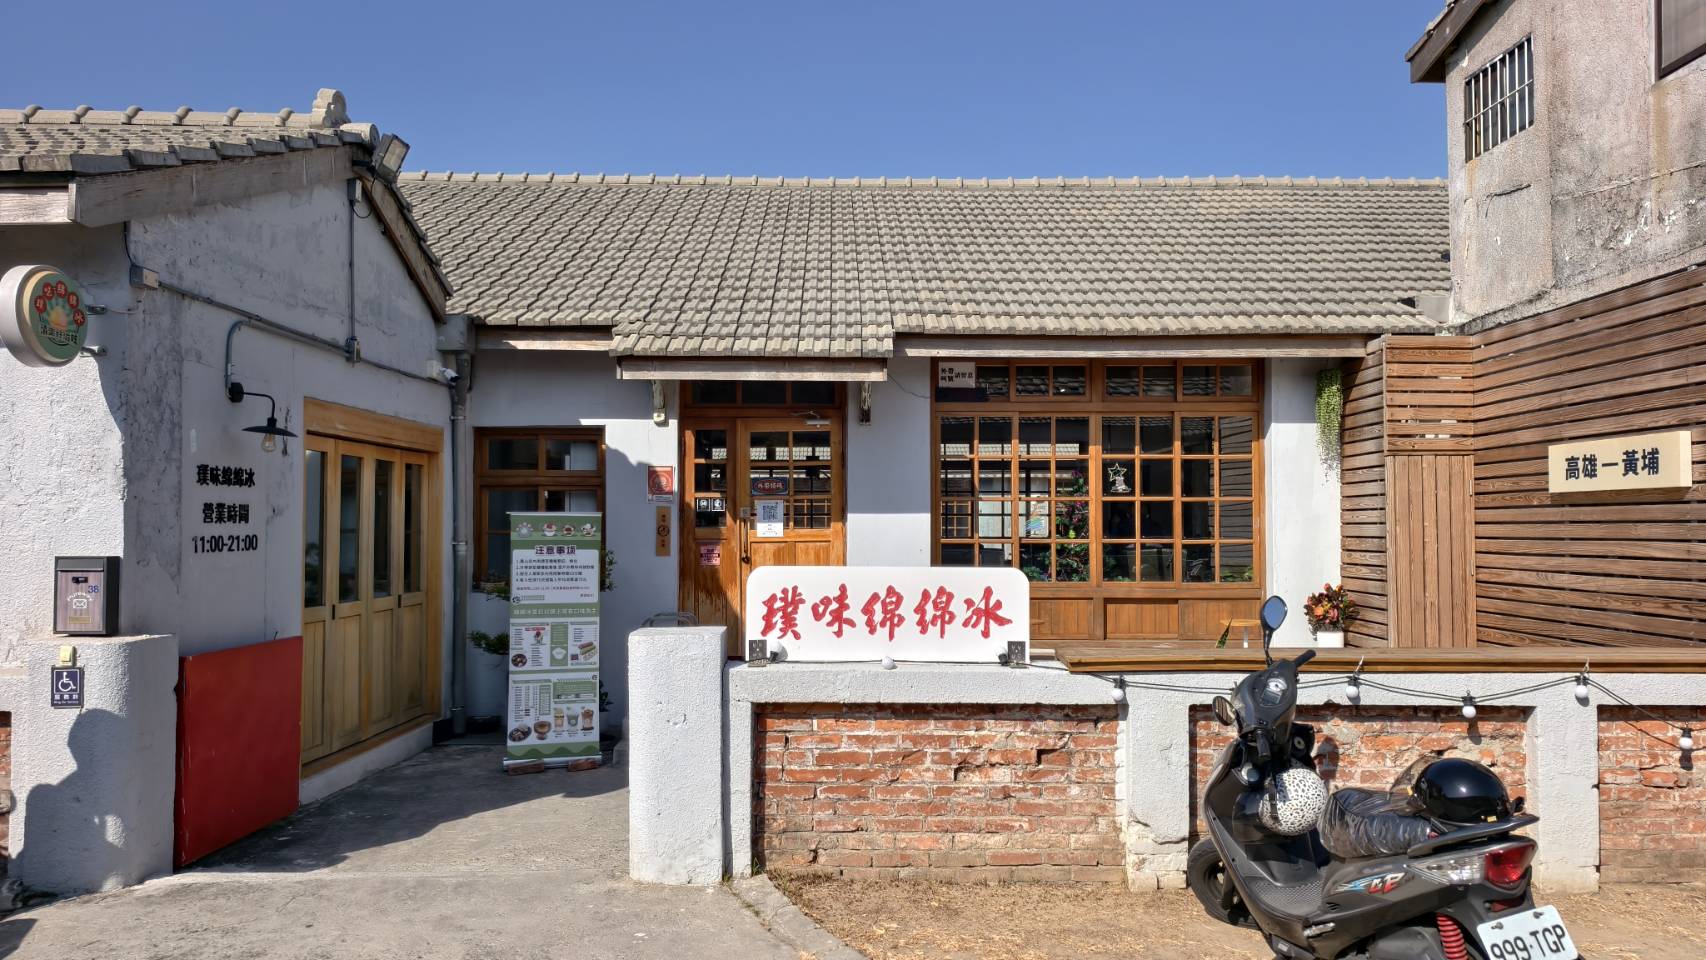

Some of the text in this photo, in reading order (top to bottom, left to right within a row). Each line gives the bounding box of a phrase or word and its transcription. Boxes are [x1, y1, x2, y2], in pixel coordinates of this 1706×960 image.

[1565, 447, 1660, 481] 高雄一黃埔
[203, 502, 250, 524] 營業時間
[192, 534, 258, 553] 11:00-21:00
